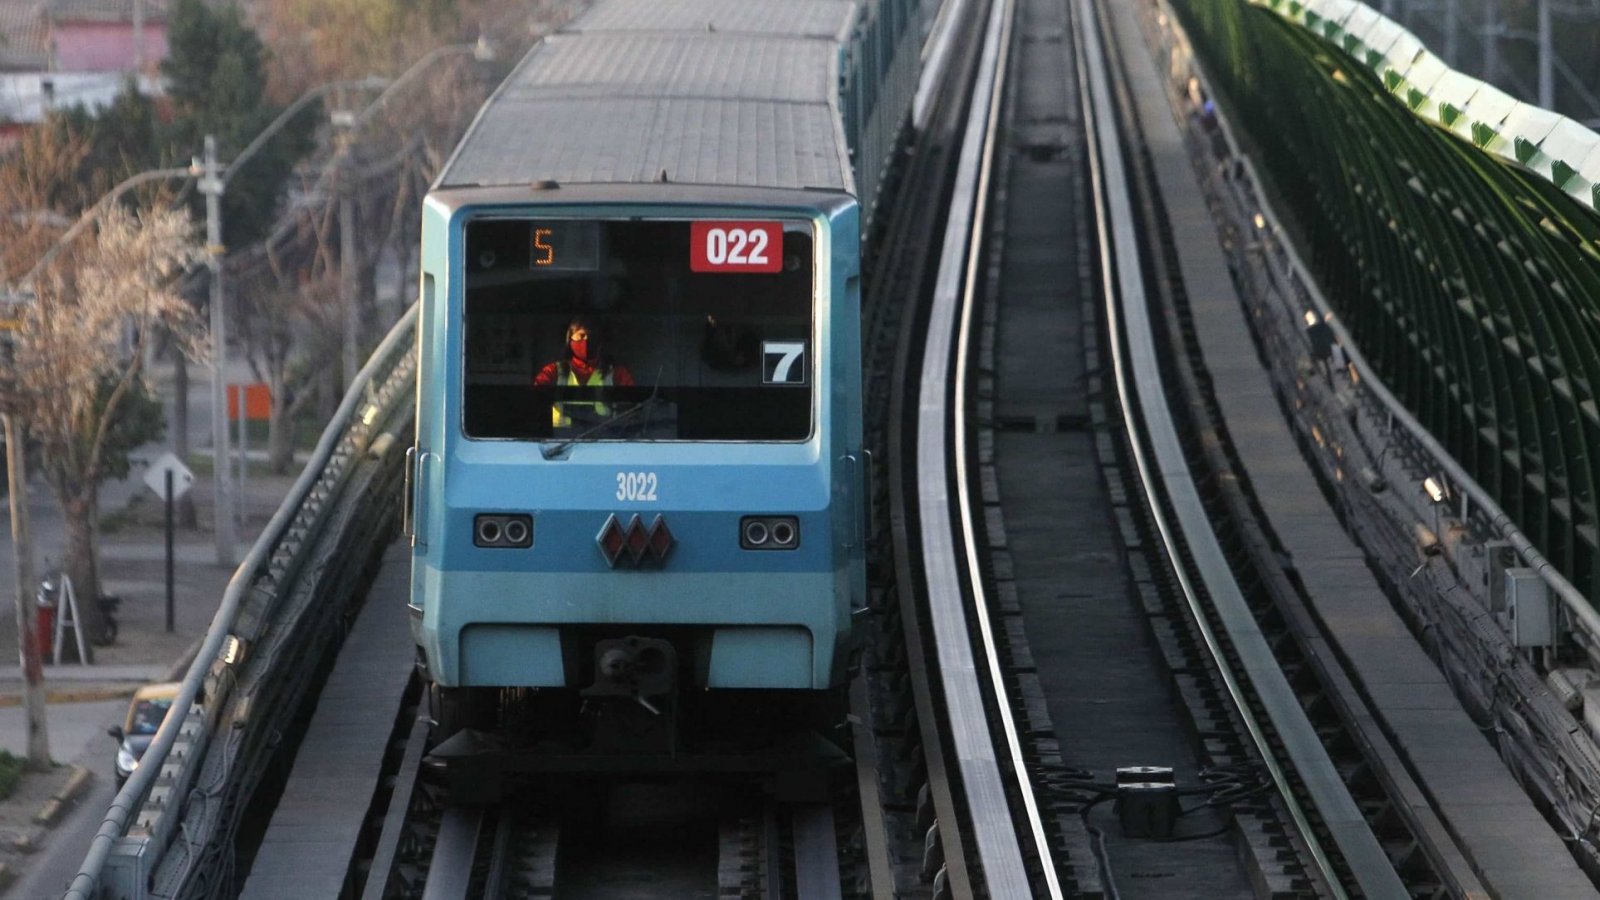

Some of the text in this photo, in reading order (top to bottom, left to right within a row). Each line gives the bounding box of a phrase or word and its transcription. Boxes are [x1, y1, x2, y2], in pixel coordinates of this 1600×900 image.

[706, 228, 768, 265] 022
[765, 344, 804, 382] 7
[616, 472, 657, 501] 3022
